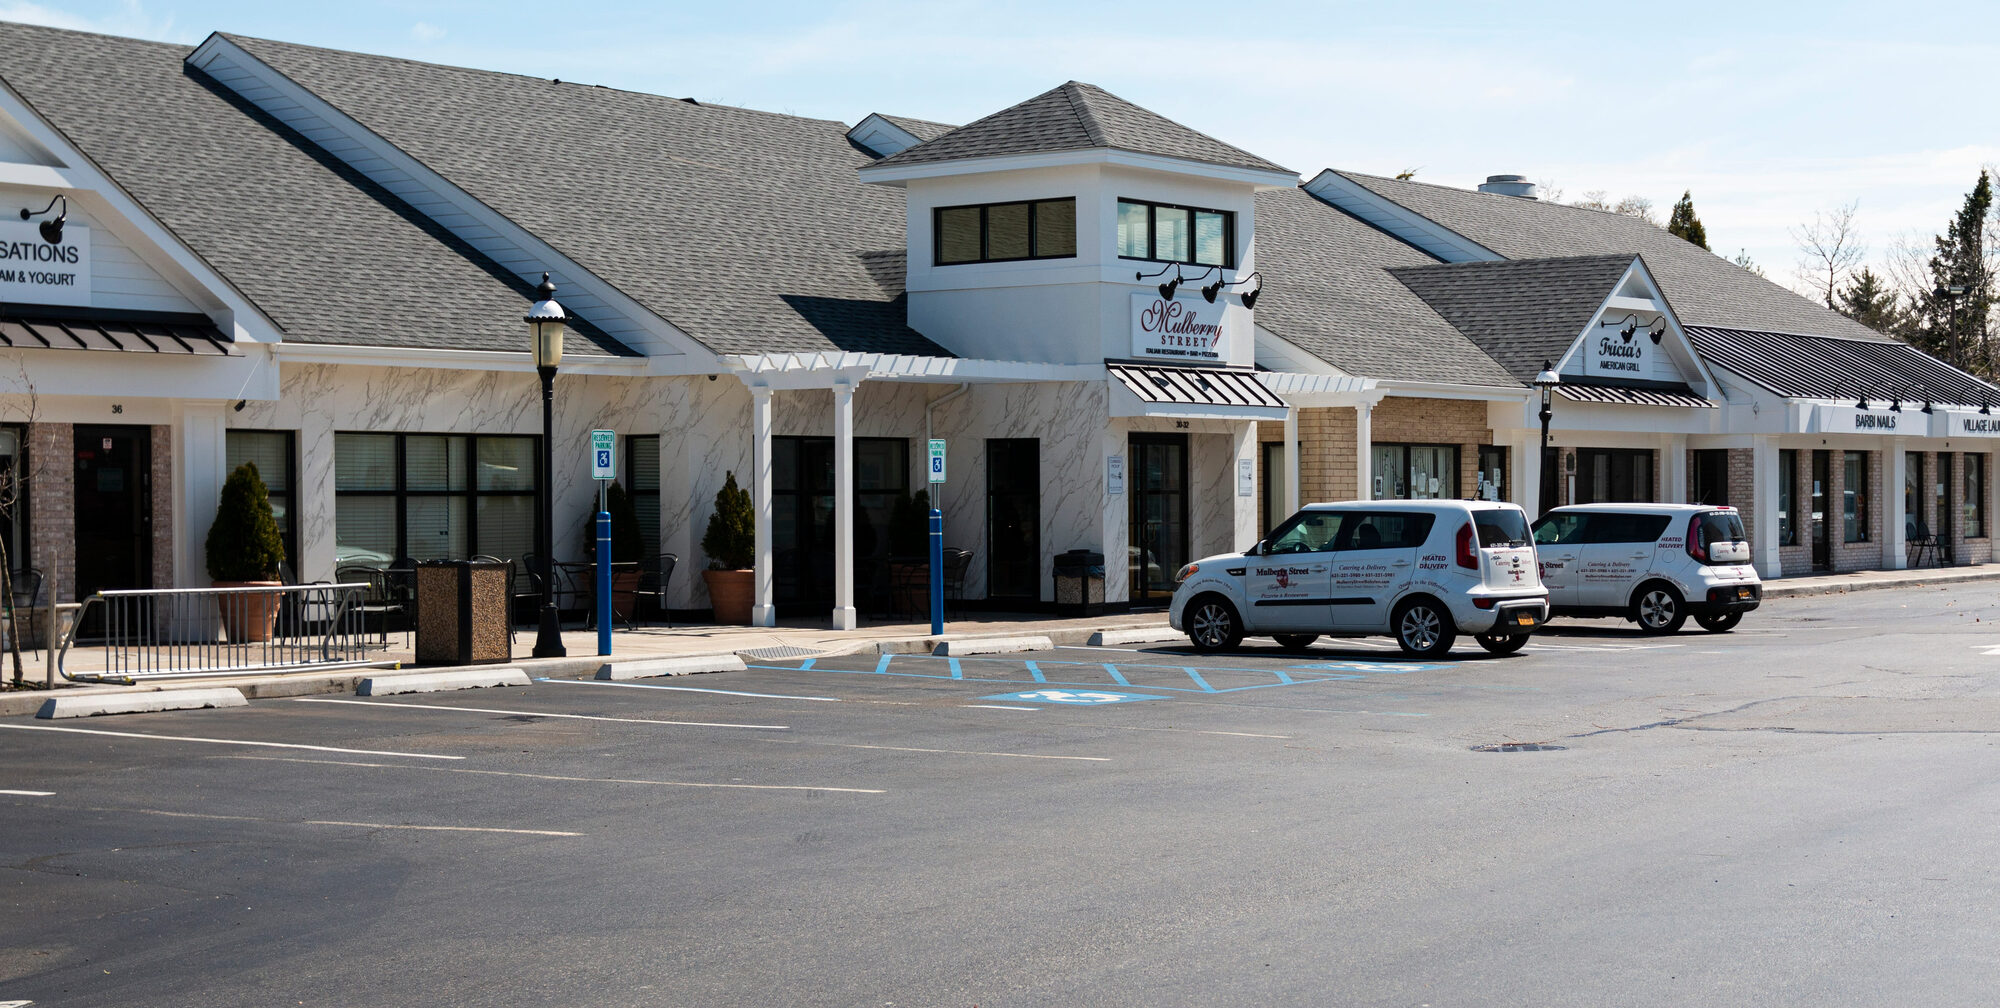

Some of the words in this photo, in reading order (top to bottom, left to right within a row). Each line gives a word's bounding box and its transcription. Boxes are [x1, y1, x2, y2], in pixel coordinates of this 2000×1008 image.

[0, 240, 79, 264] SATIONS
[18, 270, 26, 283] &
[28, 271, 76, 286] YOGURT
[1141, 299, 1223, 348] Mulberry
[1161, 335, 1208, 347] STREET
[1161, 348, 1187, 356] RESTAURANT
[1598, 337, 1642, 359] Tricia's
[1600, 360, 1626, 371] AMERICAN
[1626, 362, 1641, 372] GRILL
[111, 404, 123, 414] 36
[1855, 414, 1876, 428] BARBI
[1877, 415, 1896, 429] NAILS
[1963, 418, 1988, 432] VILLAGE
[595, 442, 612, 450] PARKING
[1545, 561, 1564, 569] Street
[1256, 567, 1288, 577] Mulberry
[1288, 567, 1310, 575] Street
